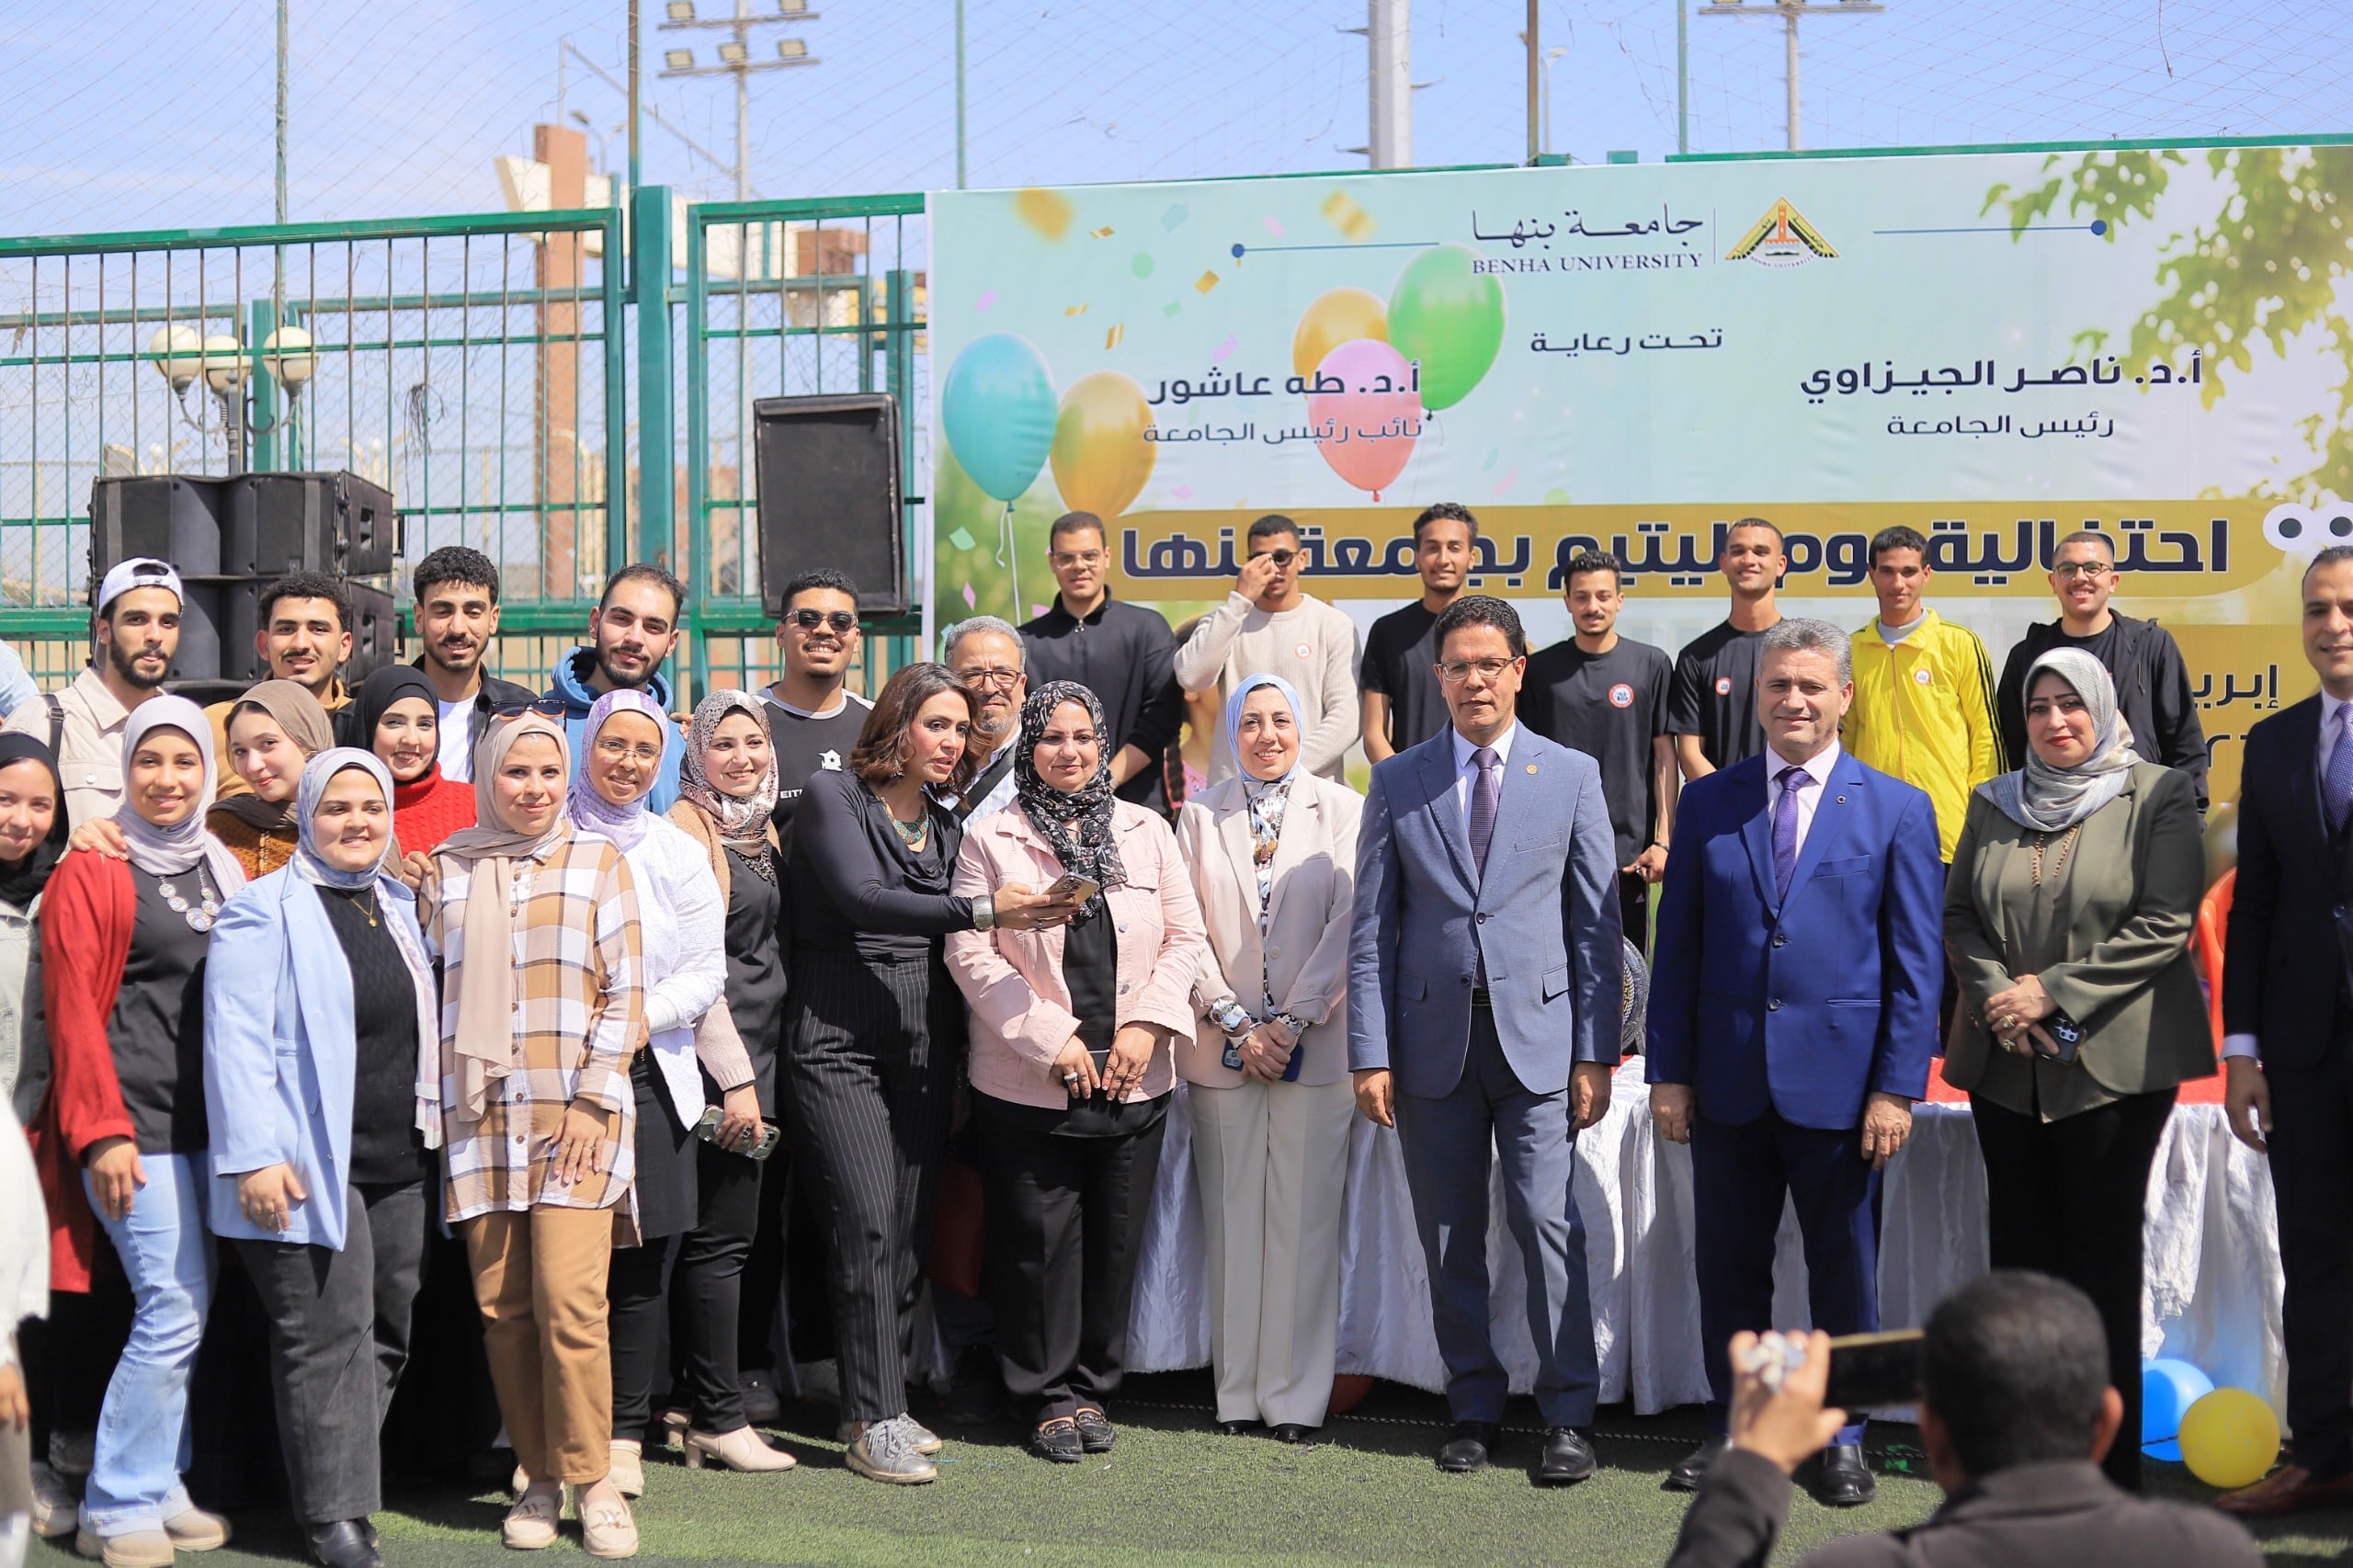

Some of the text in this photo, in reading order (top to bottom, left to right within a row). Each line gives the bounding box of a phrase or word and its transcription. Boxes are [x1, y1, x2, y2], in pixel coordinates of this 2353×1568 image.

[1472, 203, 1704, 250] جامعة بنها
[1472, 253, 1703, 274] BENHA UNIVERSITY
[1530, 328, 1723, 357] تحت رعاية
[1146, 367, 1273, 405] عاشور
[1285, 370, 1346, 394] طه
[1800, 359, 1995, 404] الجيزاوي
[2003, 356, 2122, 393] ناصر
[1142, 417, 1422, 446] نائب رئيس الجامعة
[1887, 410, 2114, 439] رئيس الجامعة
[2192, 664, 2279, 710] إبري
